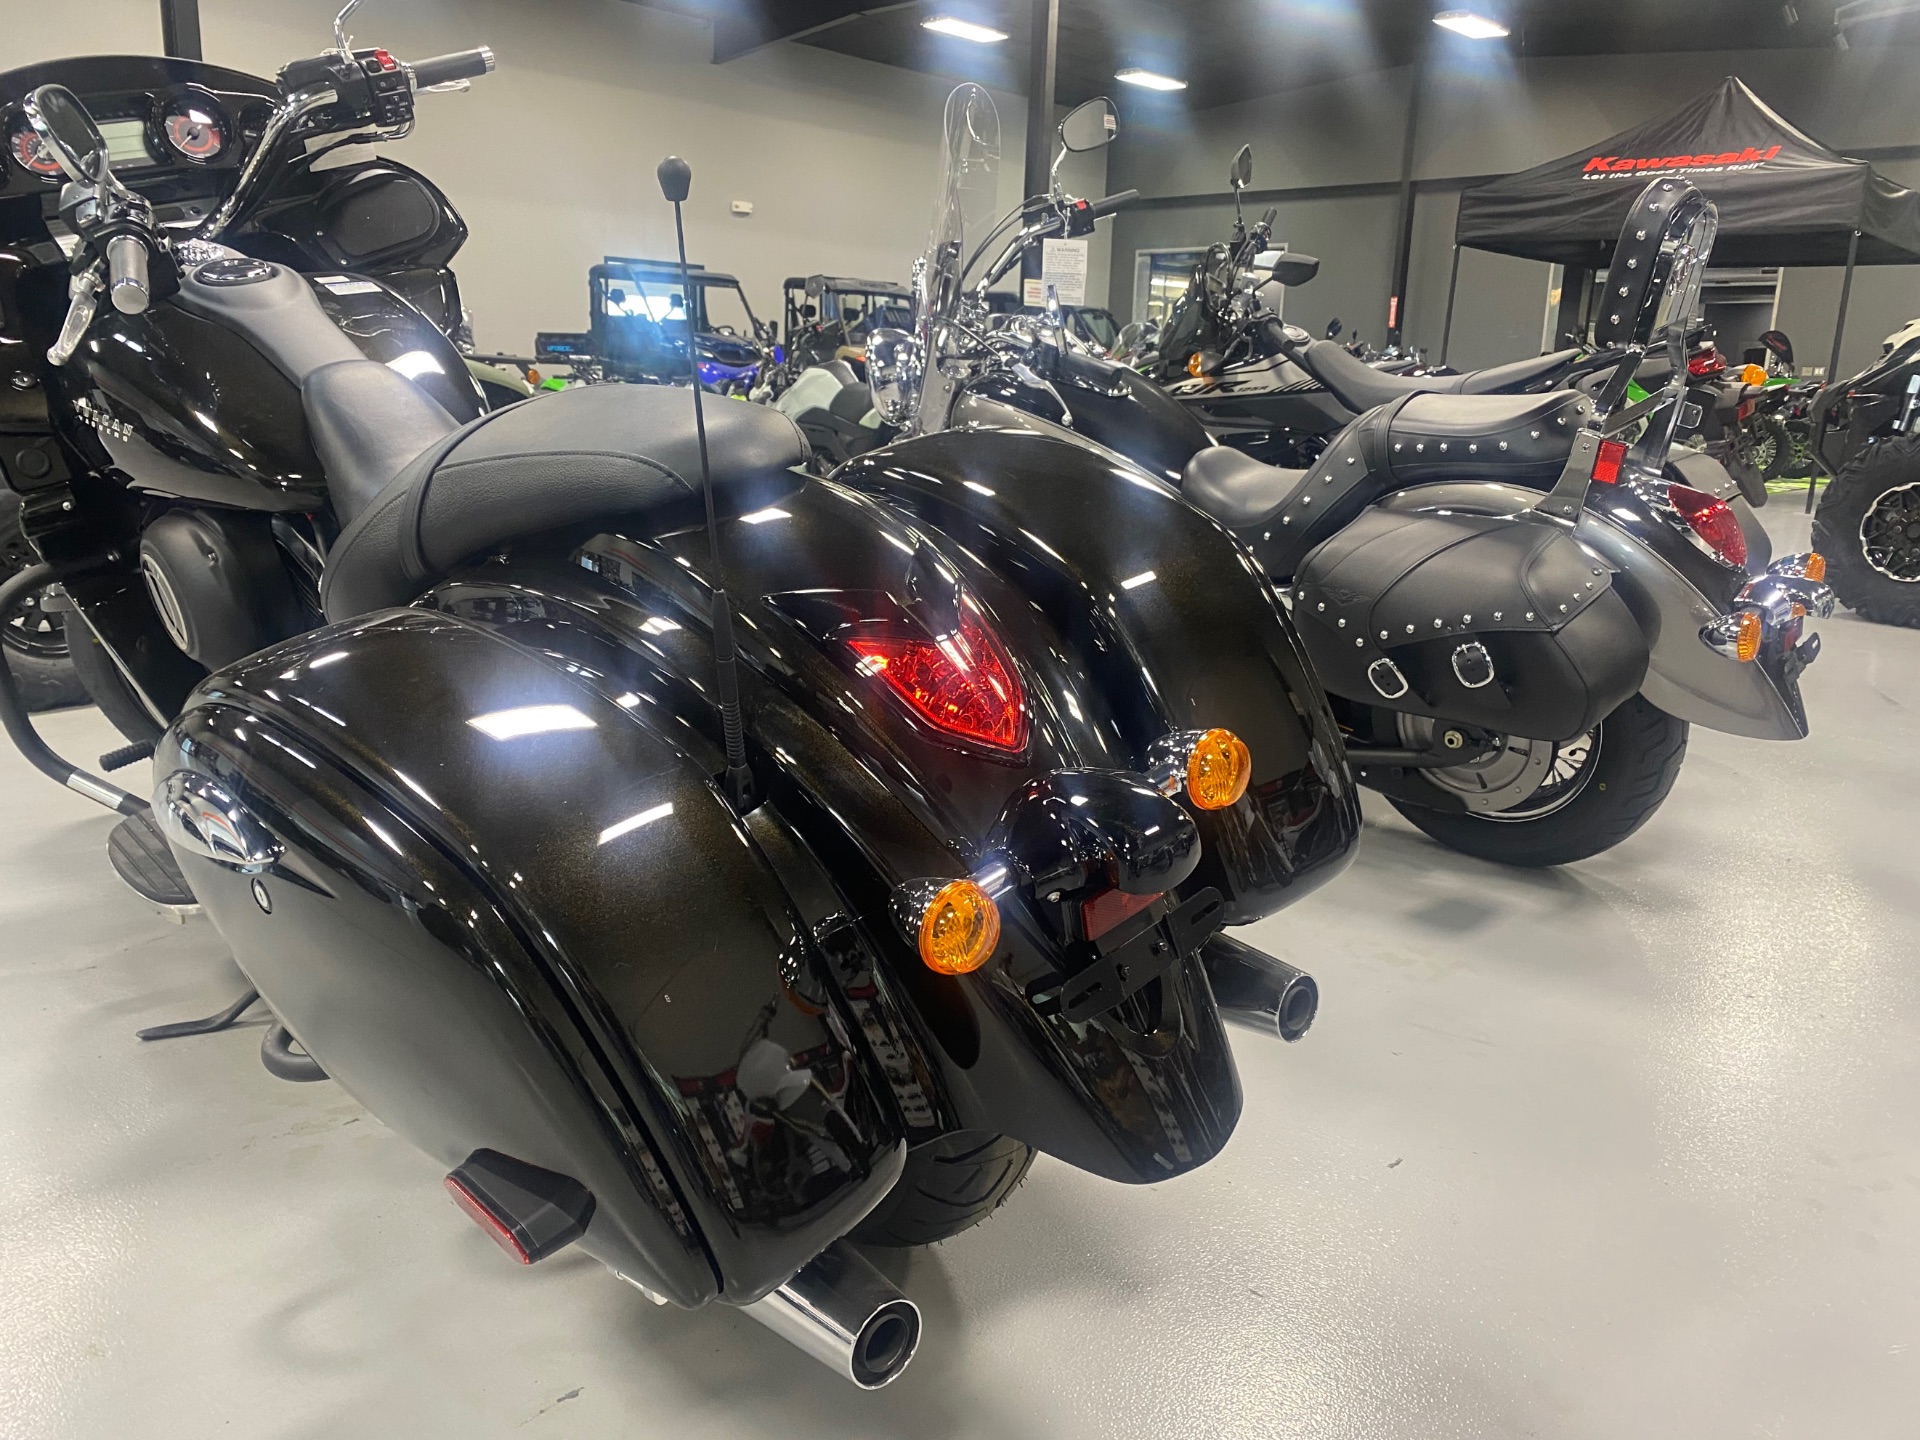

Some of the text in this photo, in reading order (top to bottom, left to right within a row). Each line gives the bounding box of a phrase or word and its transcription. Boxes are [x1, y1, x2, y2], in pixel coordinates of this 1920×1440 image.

[1583, 145, 1782, 172] Kawasaki
[1635, 168, 1677, 177] Good
[72, 399, 134, 437] VULCAN
